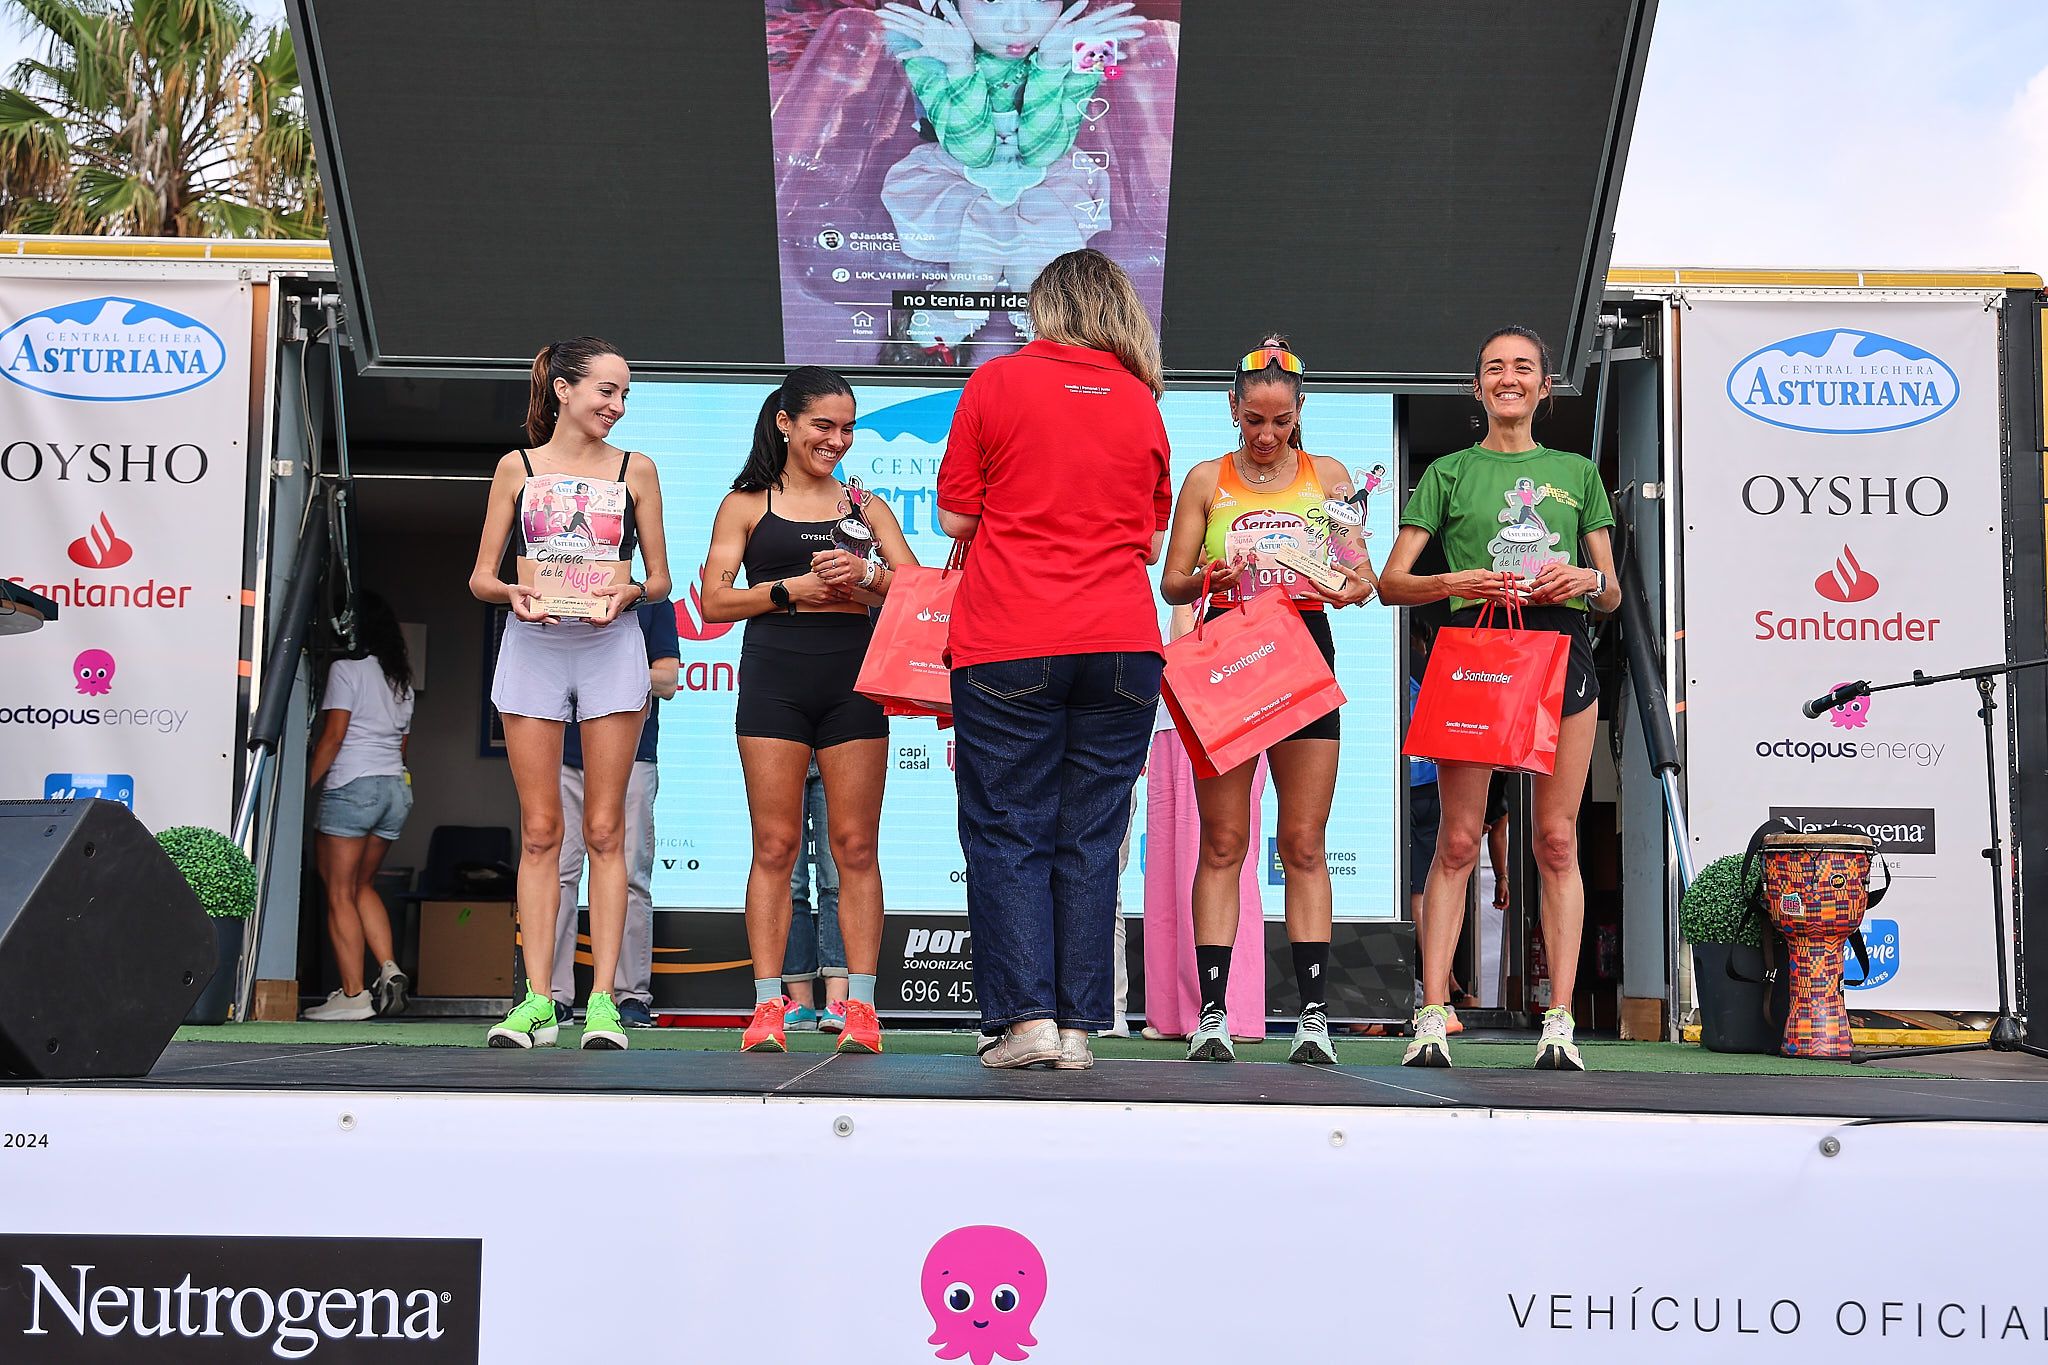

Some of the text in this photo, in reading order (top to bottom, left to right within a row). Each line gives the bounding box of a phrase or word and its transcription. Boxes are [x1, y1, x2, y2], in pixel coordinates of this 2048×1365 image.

[850, 241, 900, 251] CRINGE
[903, 294, 1029, 308] no tenía ni ide
[46, 332, 202, 343] CENTRAL LECHERA
[8, 333, 208, 374] ASTURIANA
[1780, 365, 1934, 375] CENTRAL LECHERA
[1744, 366, 1942, 406] ASTURIANA
[1, 441, 208, 483] OYSHO
[1741, 475, 1949, 517] OYSHO
[1306, 508, 1349, 537] Carrera
[1326, 503, 1357, 523] ASTURIANA
[1303, 523, 1324, 541] de la
[552, 539, 587, 547] ASTURIANA
[1492, 542, 1538, 554] Carrera
[536, 549, 584, 564] Carrera
[1499, 557, 1509, 567] de
[1512, 555, 1521, 566] la
[540, 564, 610, 593] de la Mujer
[8, 577, 192, 608] ntander
[1755, 611, 1940, 642] Santander
[1222, 641, 1276, 677] Santander
[1463, 670, 1512, 683] Santander
[0, 705, 188, 733] octopus energy
[1755, 738, 1945, 767] octopus energy
[899, 757, 930, 769] casal
[904, 928, 972, 958] por
[903, 959, 973, 970] SONORIZAC
[1866, 970, 1889, 986] ALPES
[901, 980, 978, 1003] 696 45
[3, 1133, 49, 1149] 2024
[1508, 1286, 1801, 1334] VEHÍCULO
